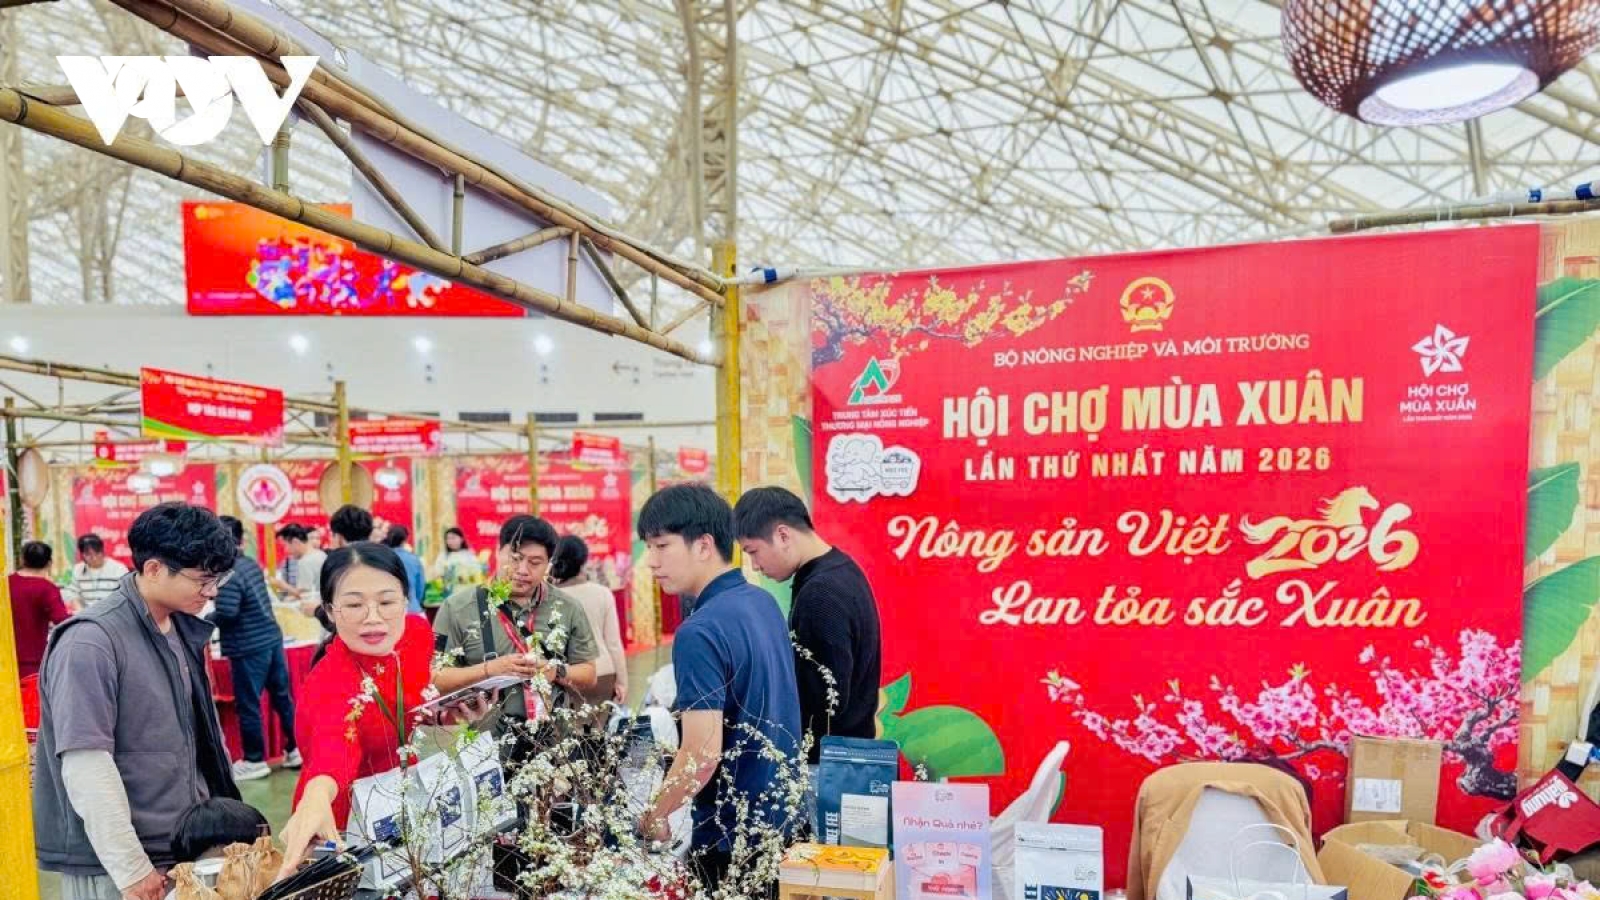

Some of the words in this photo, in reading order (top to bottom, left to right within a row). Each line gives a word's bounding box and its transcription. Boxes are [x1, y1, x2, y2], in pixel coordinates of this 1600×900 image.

[993, 350, 1019, 368] BỘ
[1021, 346, 1076, 365] NÔNG
[1079, 341, 1148, 362] NGHIỆP
[1152, 338, 1179, 357] VÀ
[1182, 336, 1221, 355] MÔI
[1226, 334, 1310, 352] TRƯỜNG
[943, 386, 1009, 446] HỘI
[1023, 385, 1109, 441] CHỢ
[1121, 375, 1223, 431] MÙA
[1236, 369, 1364, 426] XUÂN
[1400, 399, 1432, 413] MÙA
[1436, 396, 1477, 412] XUÂN
[1408, 384, 1433, 399] HỘI
[1436, 383, 1469, 398] CHỢ
[964, 451, 1014, 481] LẦN
[1029, 451, 1080, 480] THỨ
[1091, 444, 1166, 478] NHẤT
[1179, 446, 1244, 475] NĂM
[1258, 447, 1331, 472] 2026
[887, 515, 1018, 573] Nông
[1026, 516, 1110, 557] sản
[1116, 508, 1232, 565] Việt
[1240, 500, 1420, 580] 2026
[979, 580, 1086, 626] Lan
[1093, 585, 1177, 626] tỏa
[1184, 578, 1269, 626] sắc
[1276, 579, 1428, 627] Xuân
